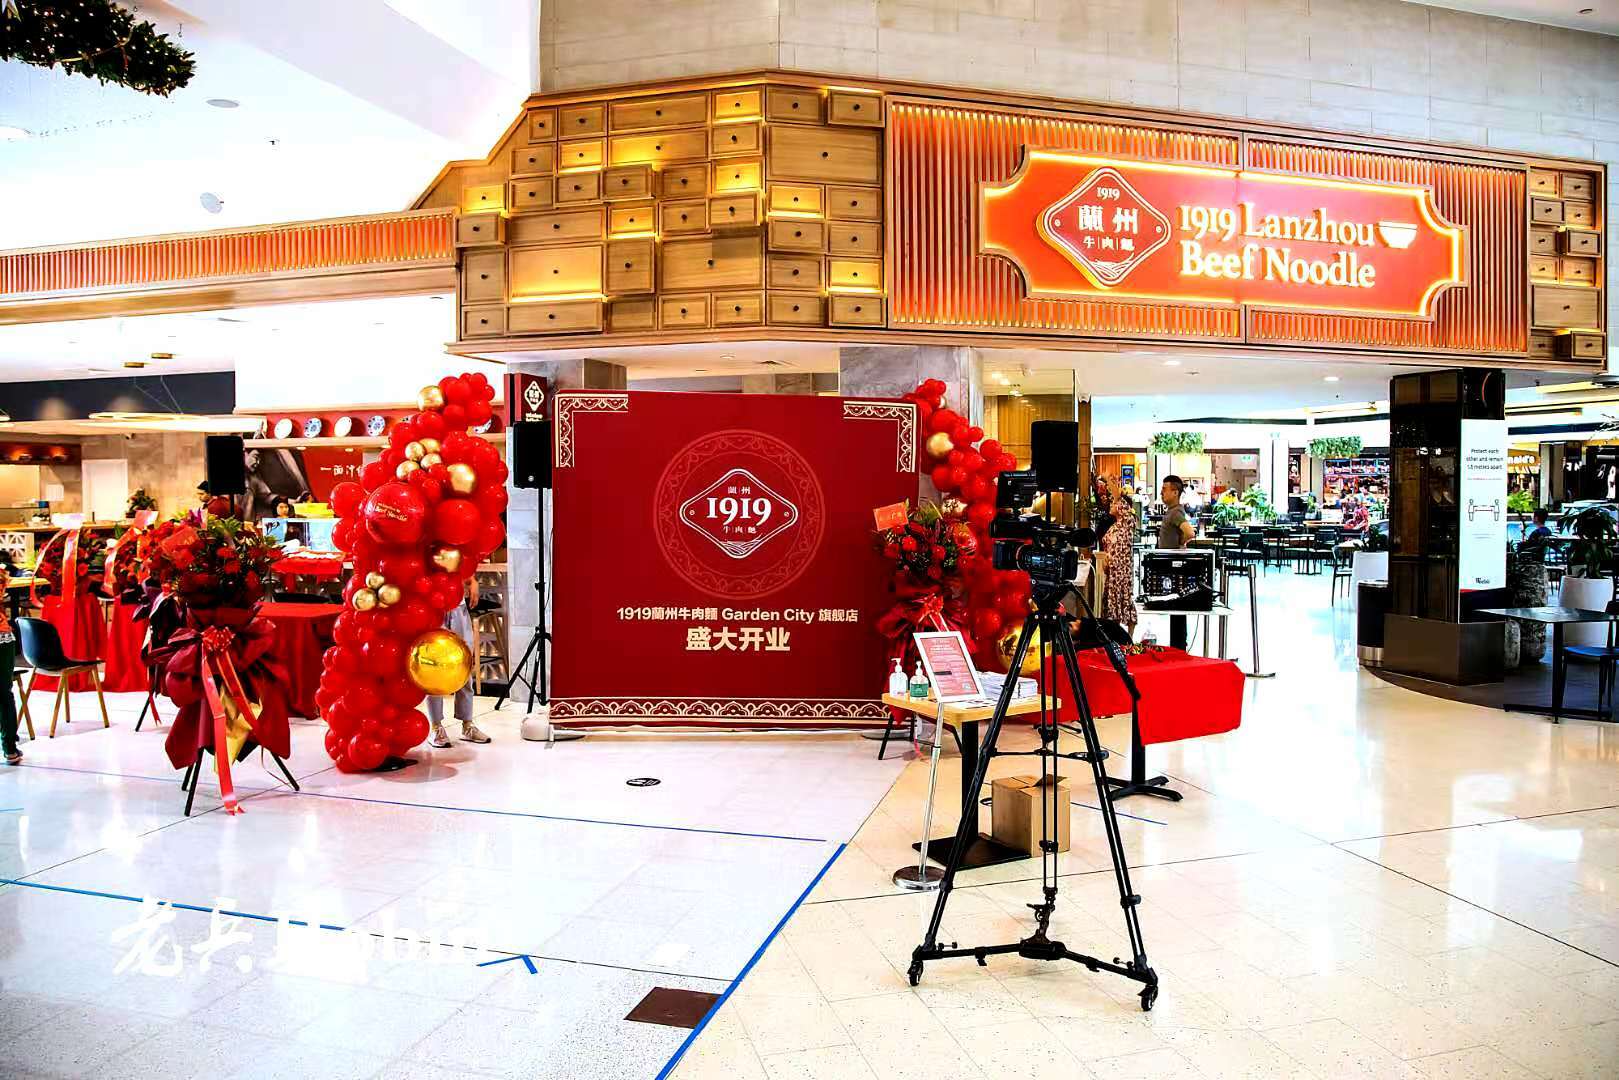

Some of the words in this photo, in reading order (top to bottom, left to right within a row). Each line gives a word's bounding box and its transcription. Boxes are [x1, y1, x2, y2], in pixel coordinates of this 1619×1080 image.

[1096, 187, 1121, 201] 1919
[1179, 204, 1237, 241] 1919
[1239, 201, 1376, 247] Lanzhou
[1179, 239, 1259, 281] Beef
[1262, 246, 1377, 289] Noodle
[706, 497, 772, 526] 1919
[722, 607, 780, 622] Garden
[784, 608, 815, 625] City
[818, 608, 859, 623] 旗舰店
[685, 626, 791, 652] 盛大开业
